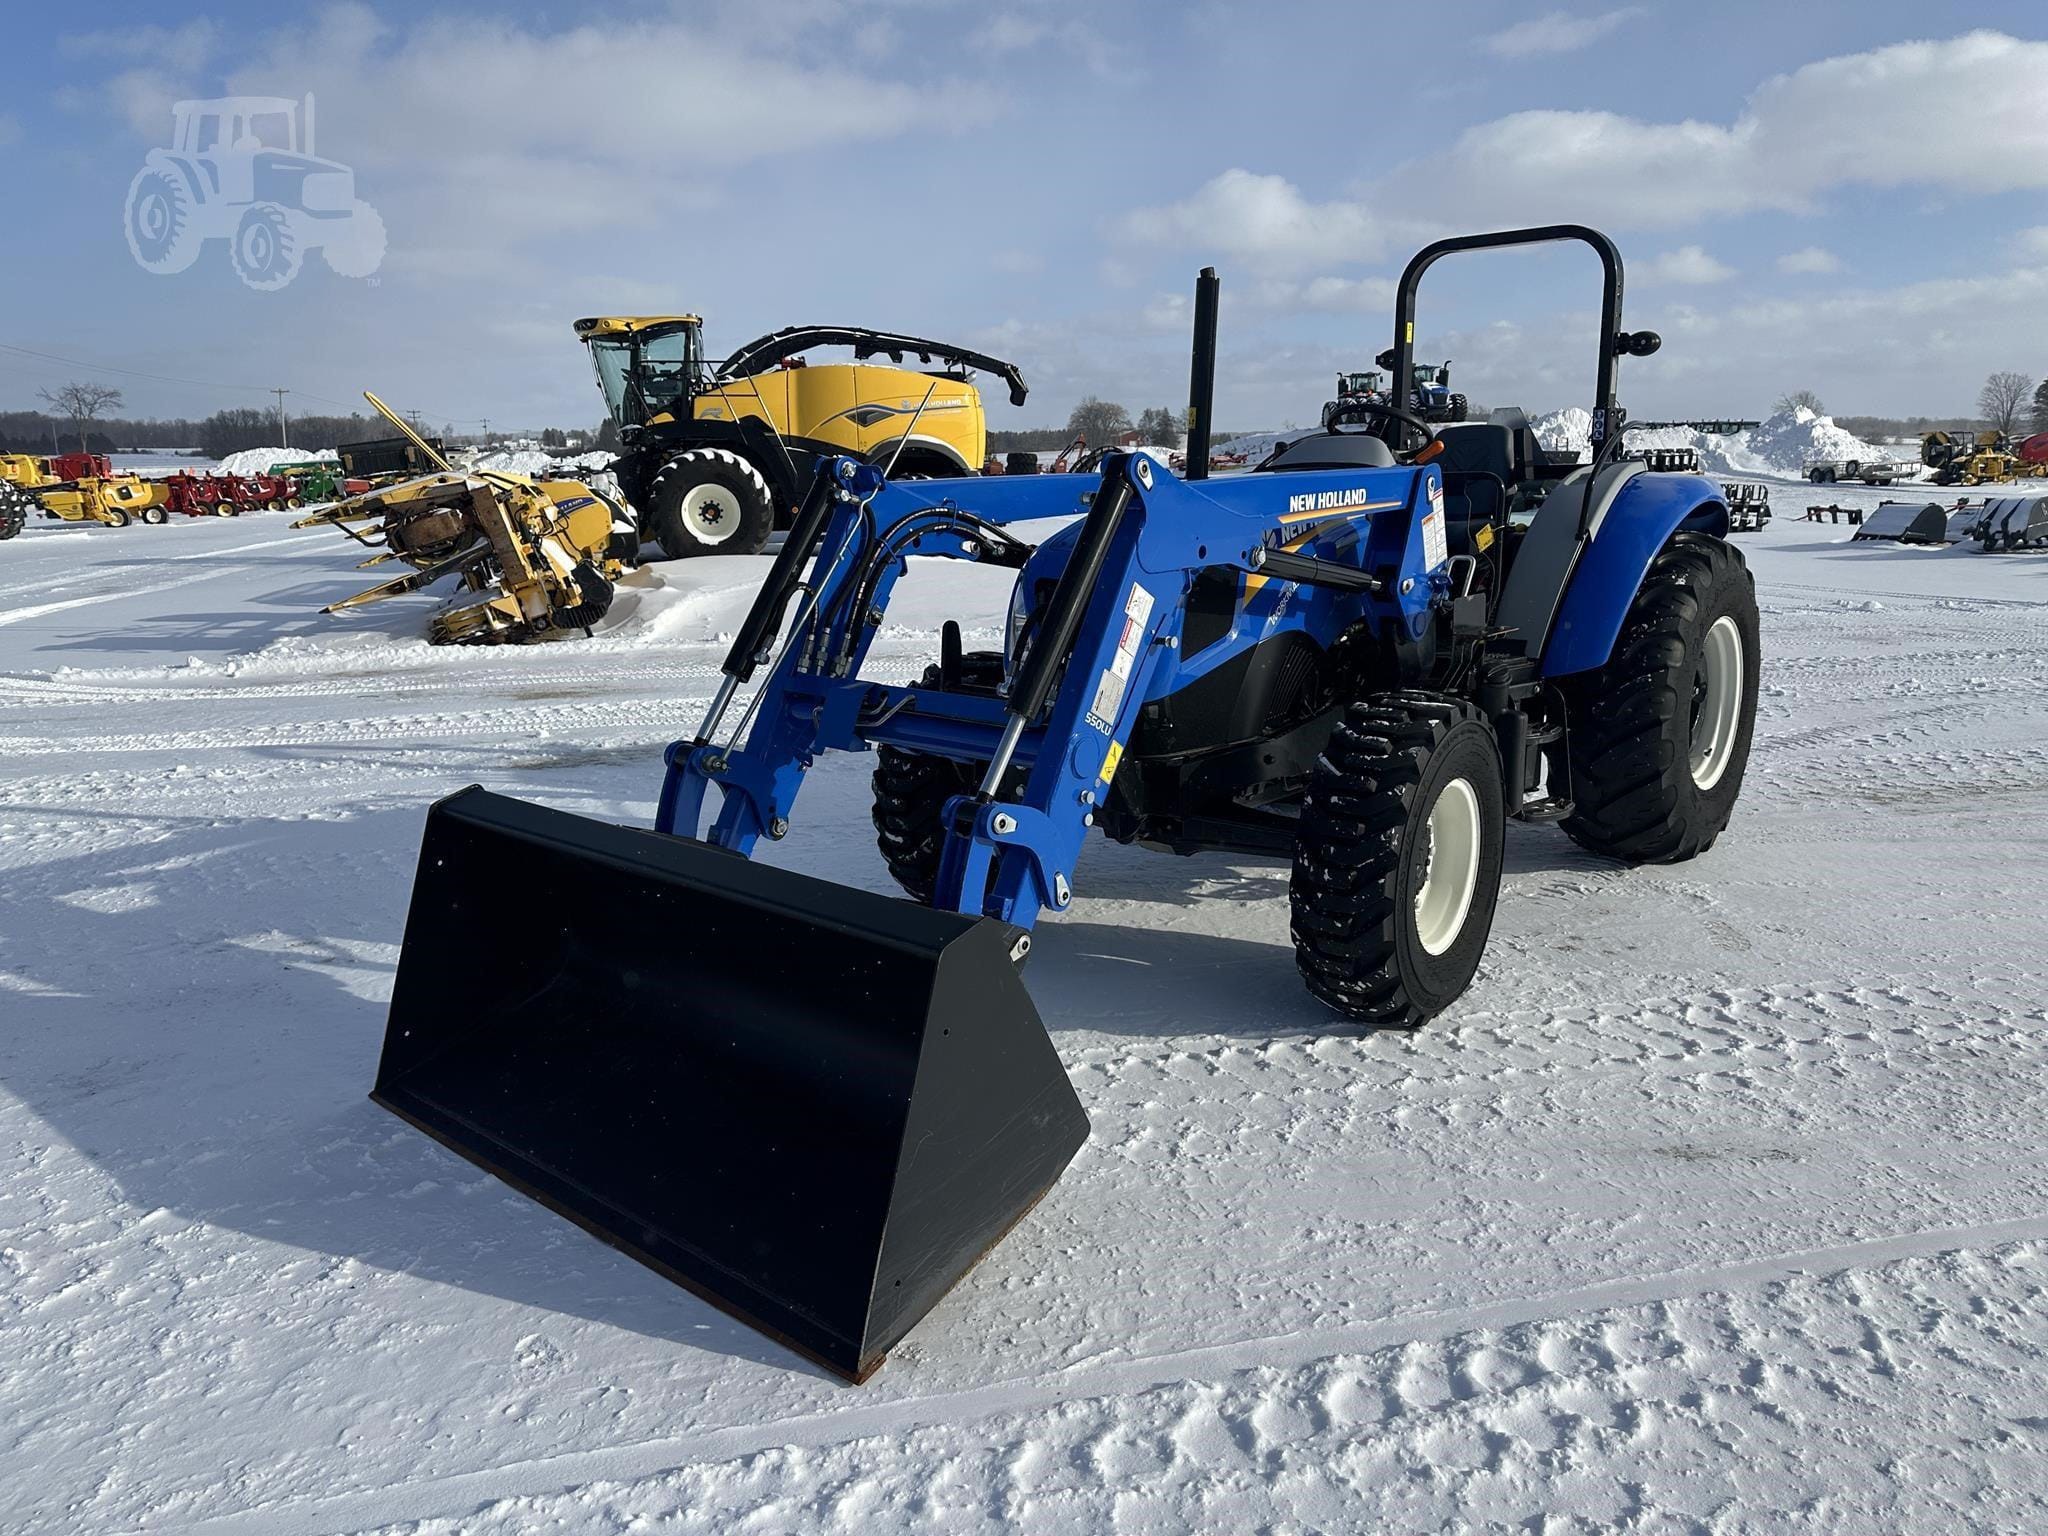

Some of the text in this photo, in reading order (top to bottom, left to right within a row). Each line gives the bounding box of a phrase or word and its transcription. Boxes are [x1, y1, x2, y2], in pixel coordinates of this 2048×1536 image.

[1289, 488, 1367, 512] NEW HOLLAND
[1269, 581, 1300, 626] WORKMA
